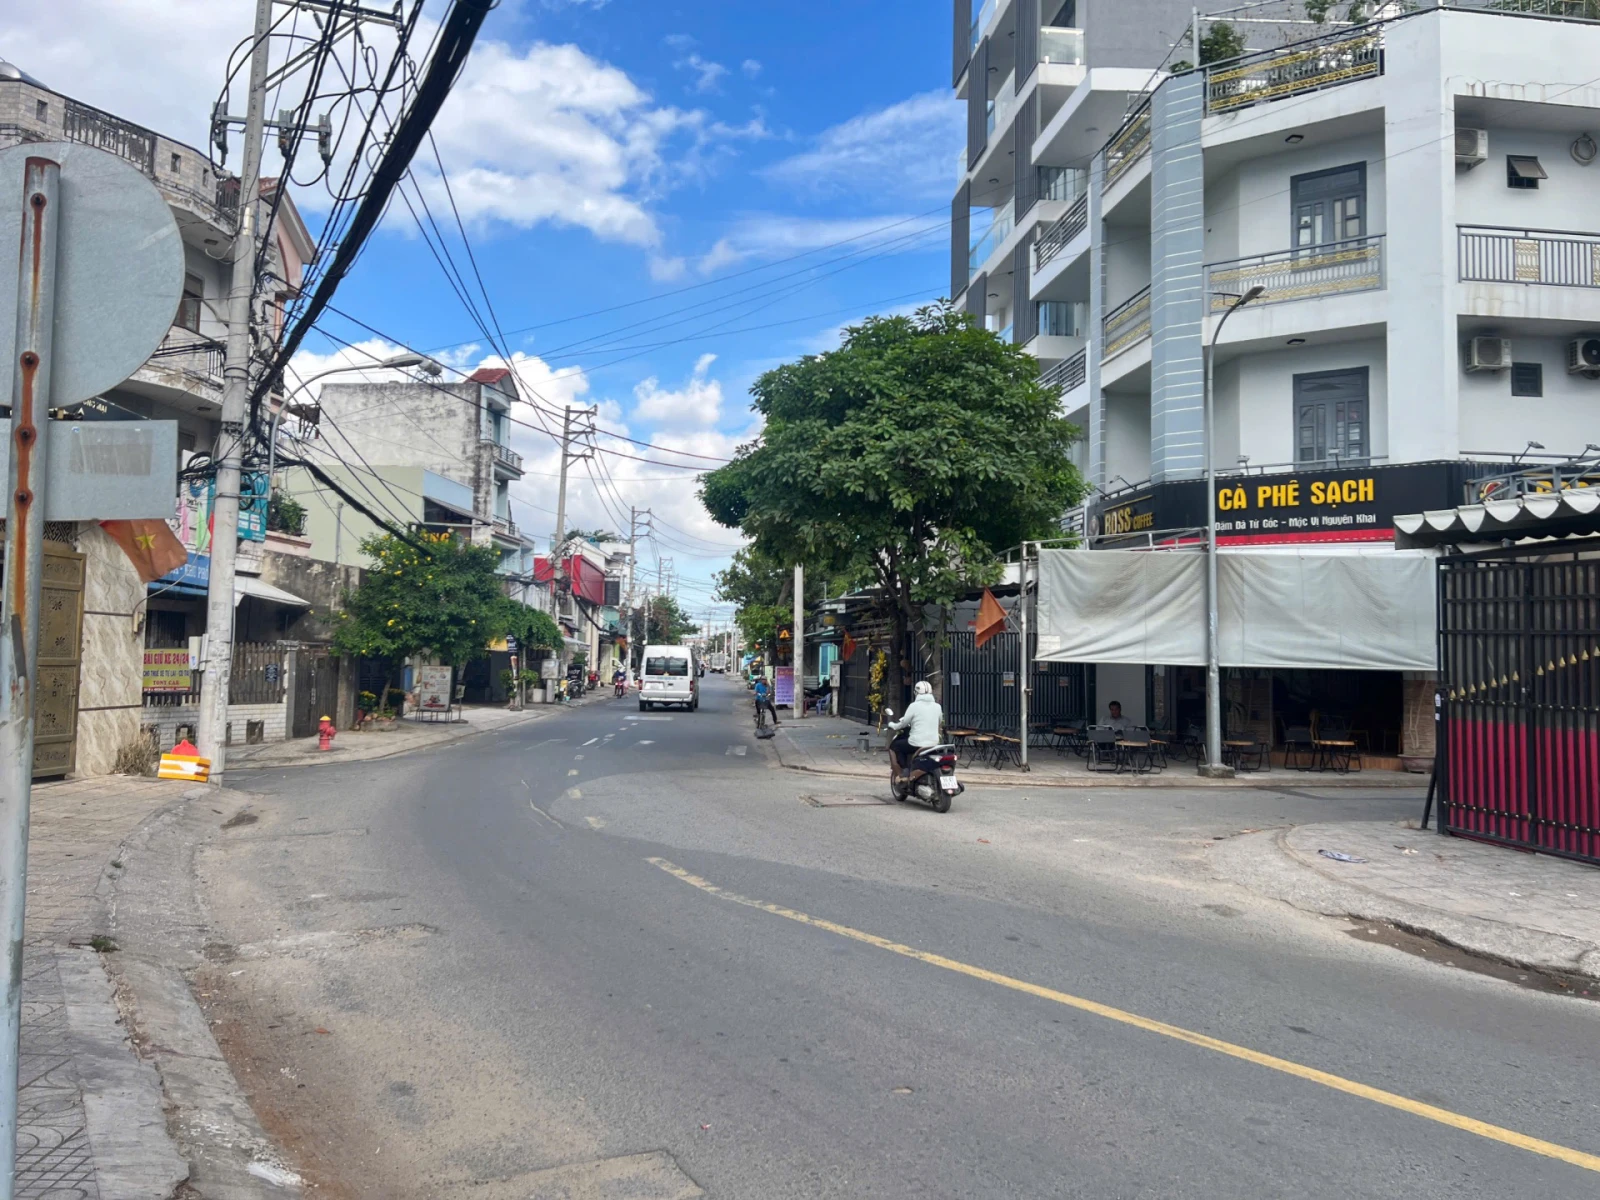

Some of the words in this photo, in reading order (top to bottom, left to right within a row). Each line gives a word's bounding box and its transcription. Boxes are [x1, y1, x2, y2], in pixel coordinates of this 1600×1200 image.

[1218, 483, 1247, 511] CÀ
[1257, 480, 1300, 508] PHÊ
[1310, 478, 1374, 508] SẠCH
[1104, 507, 1131, 536] BOSS
[1133, 512, 1153, 530] COFFEE
[1356, 513, 1376, 524] Khai
